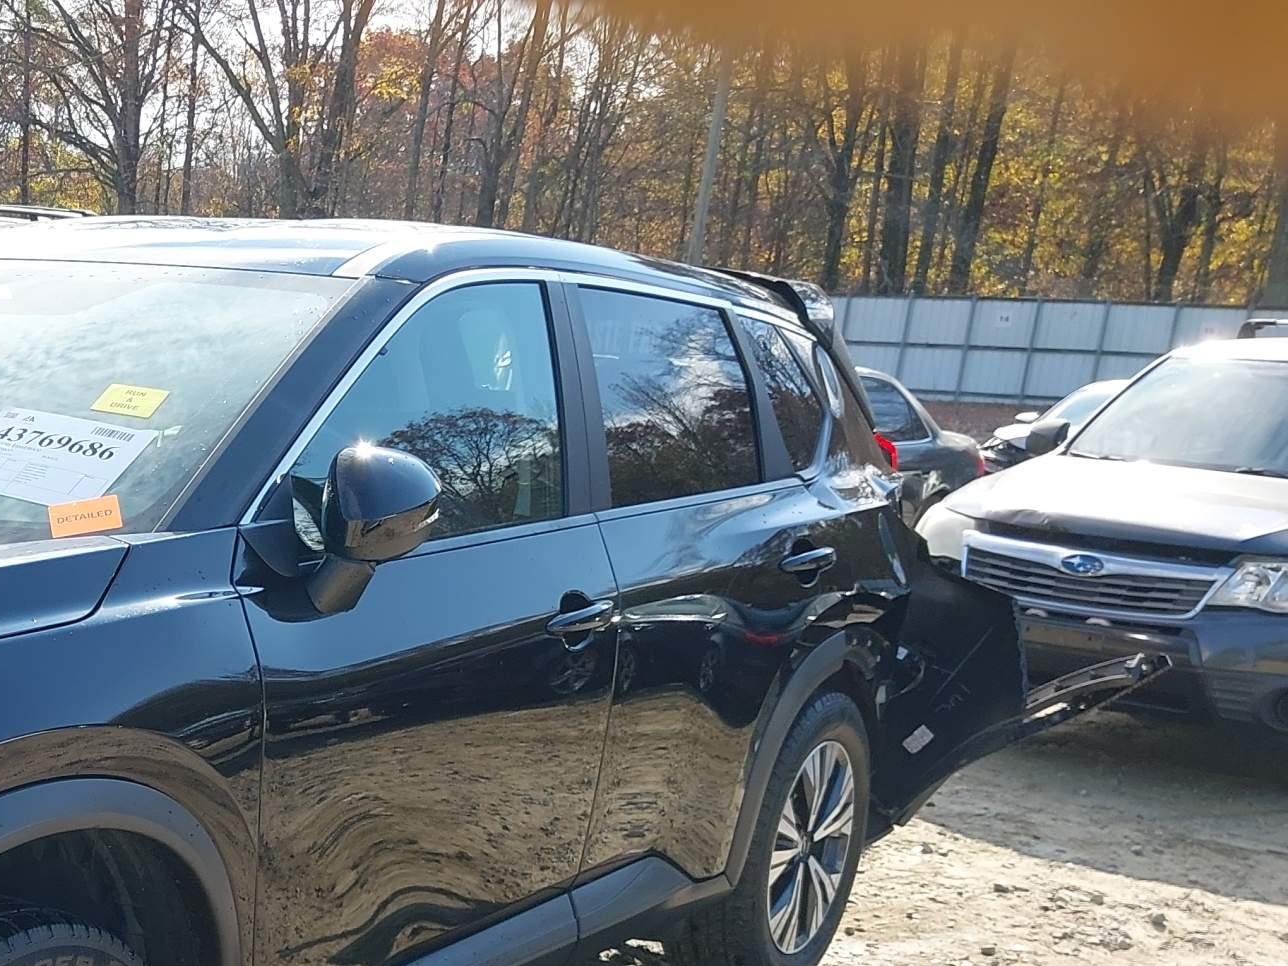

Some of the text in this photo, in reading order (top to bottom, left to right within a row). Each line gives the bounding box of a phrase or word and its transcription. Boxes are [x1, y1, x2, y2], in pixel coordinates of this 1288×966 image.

[125, 389, 147, 397] RUN
[110, 402, 140, 410] DRIVE
[56, 509, 113, 524] DETAILED
